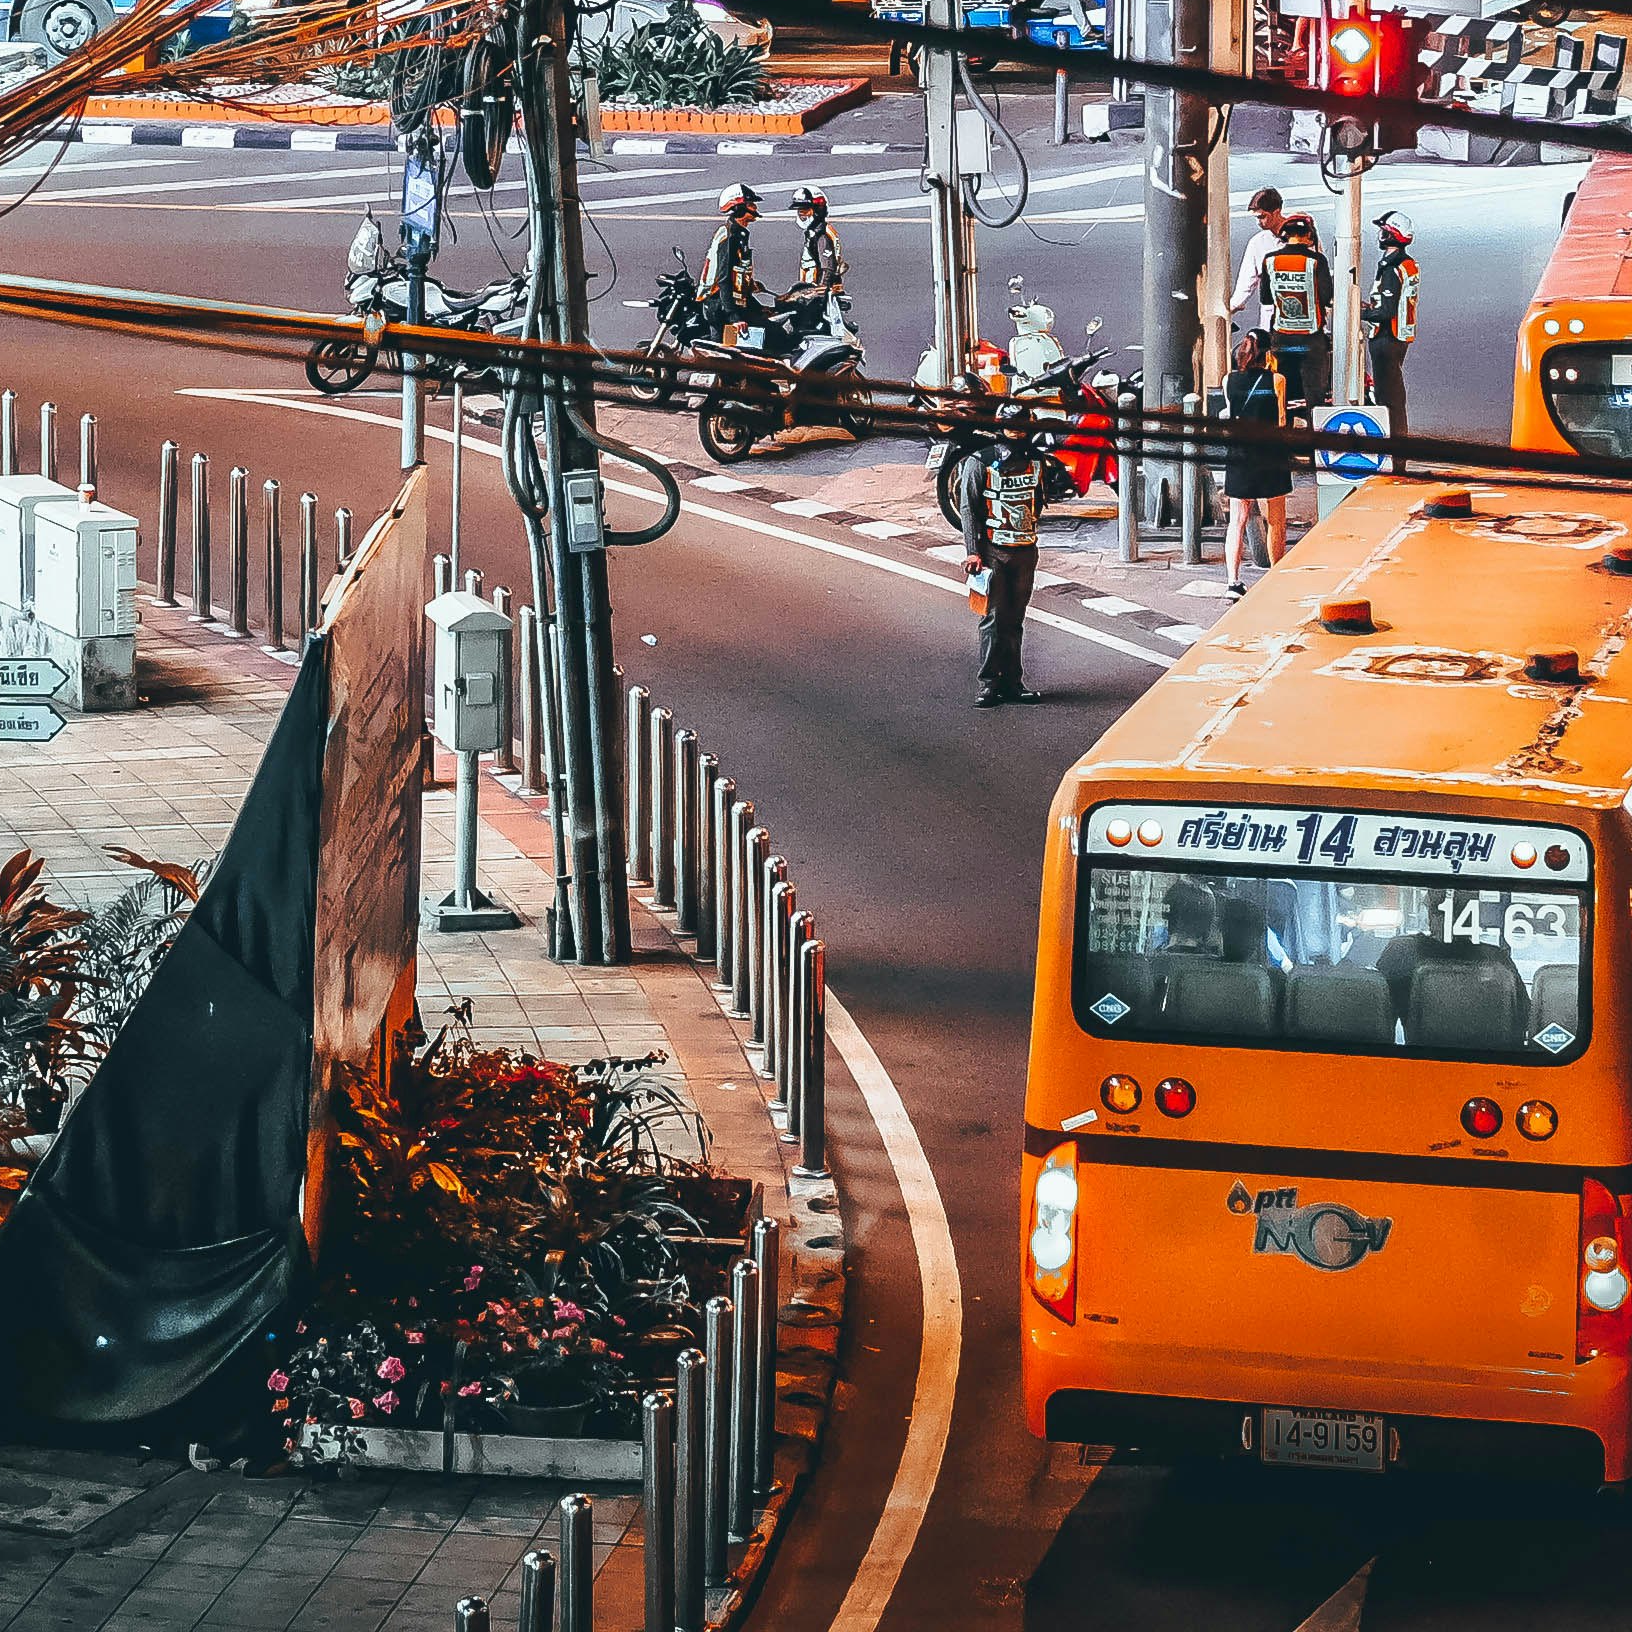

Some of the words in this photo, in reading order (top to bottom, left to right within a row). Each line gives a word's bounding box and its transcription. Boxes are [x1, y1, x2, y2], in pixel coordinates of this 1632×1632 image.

[1275, 272, 1306, 282] POLICE
[1001, 476, 1037, 488] POLICE
[1176, 809, 1288, 854] ศรีย่าน
[1295, 813, 1359, 866] 14
[1372, 824, 1497, 873] สวนลุม
[1437, 899, 1567, 945] 14-63
[1274, 1418, 1378, 1454] 14-9159
